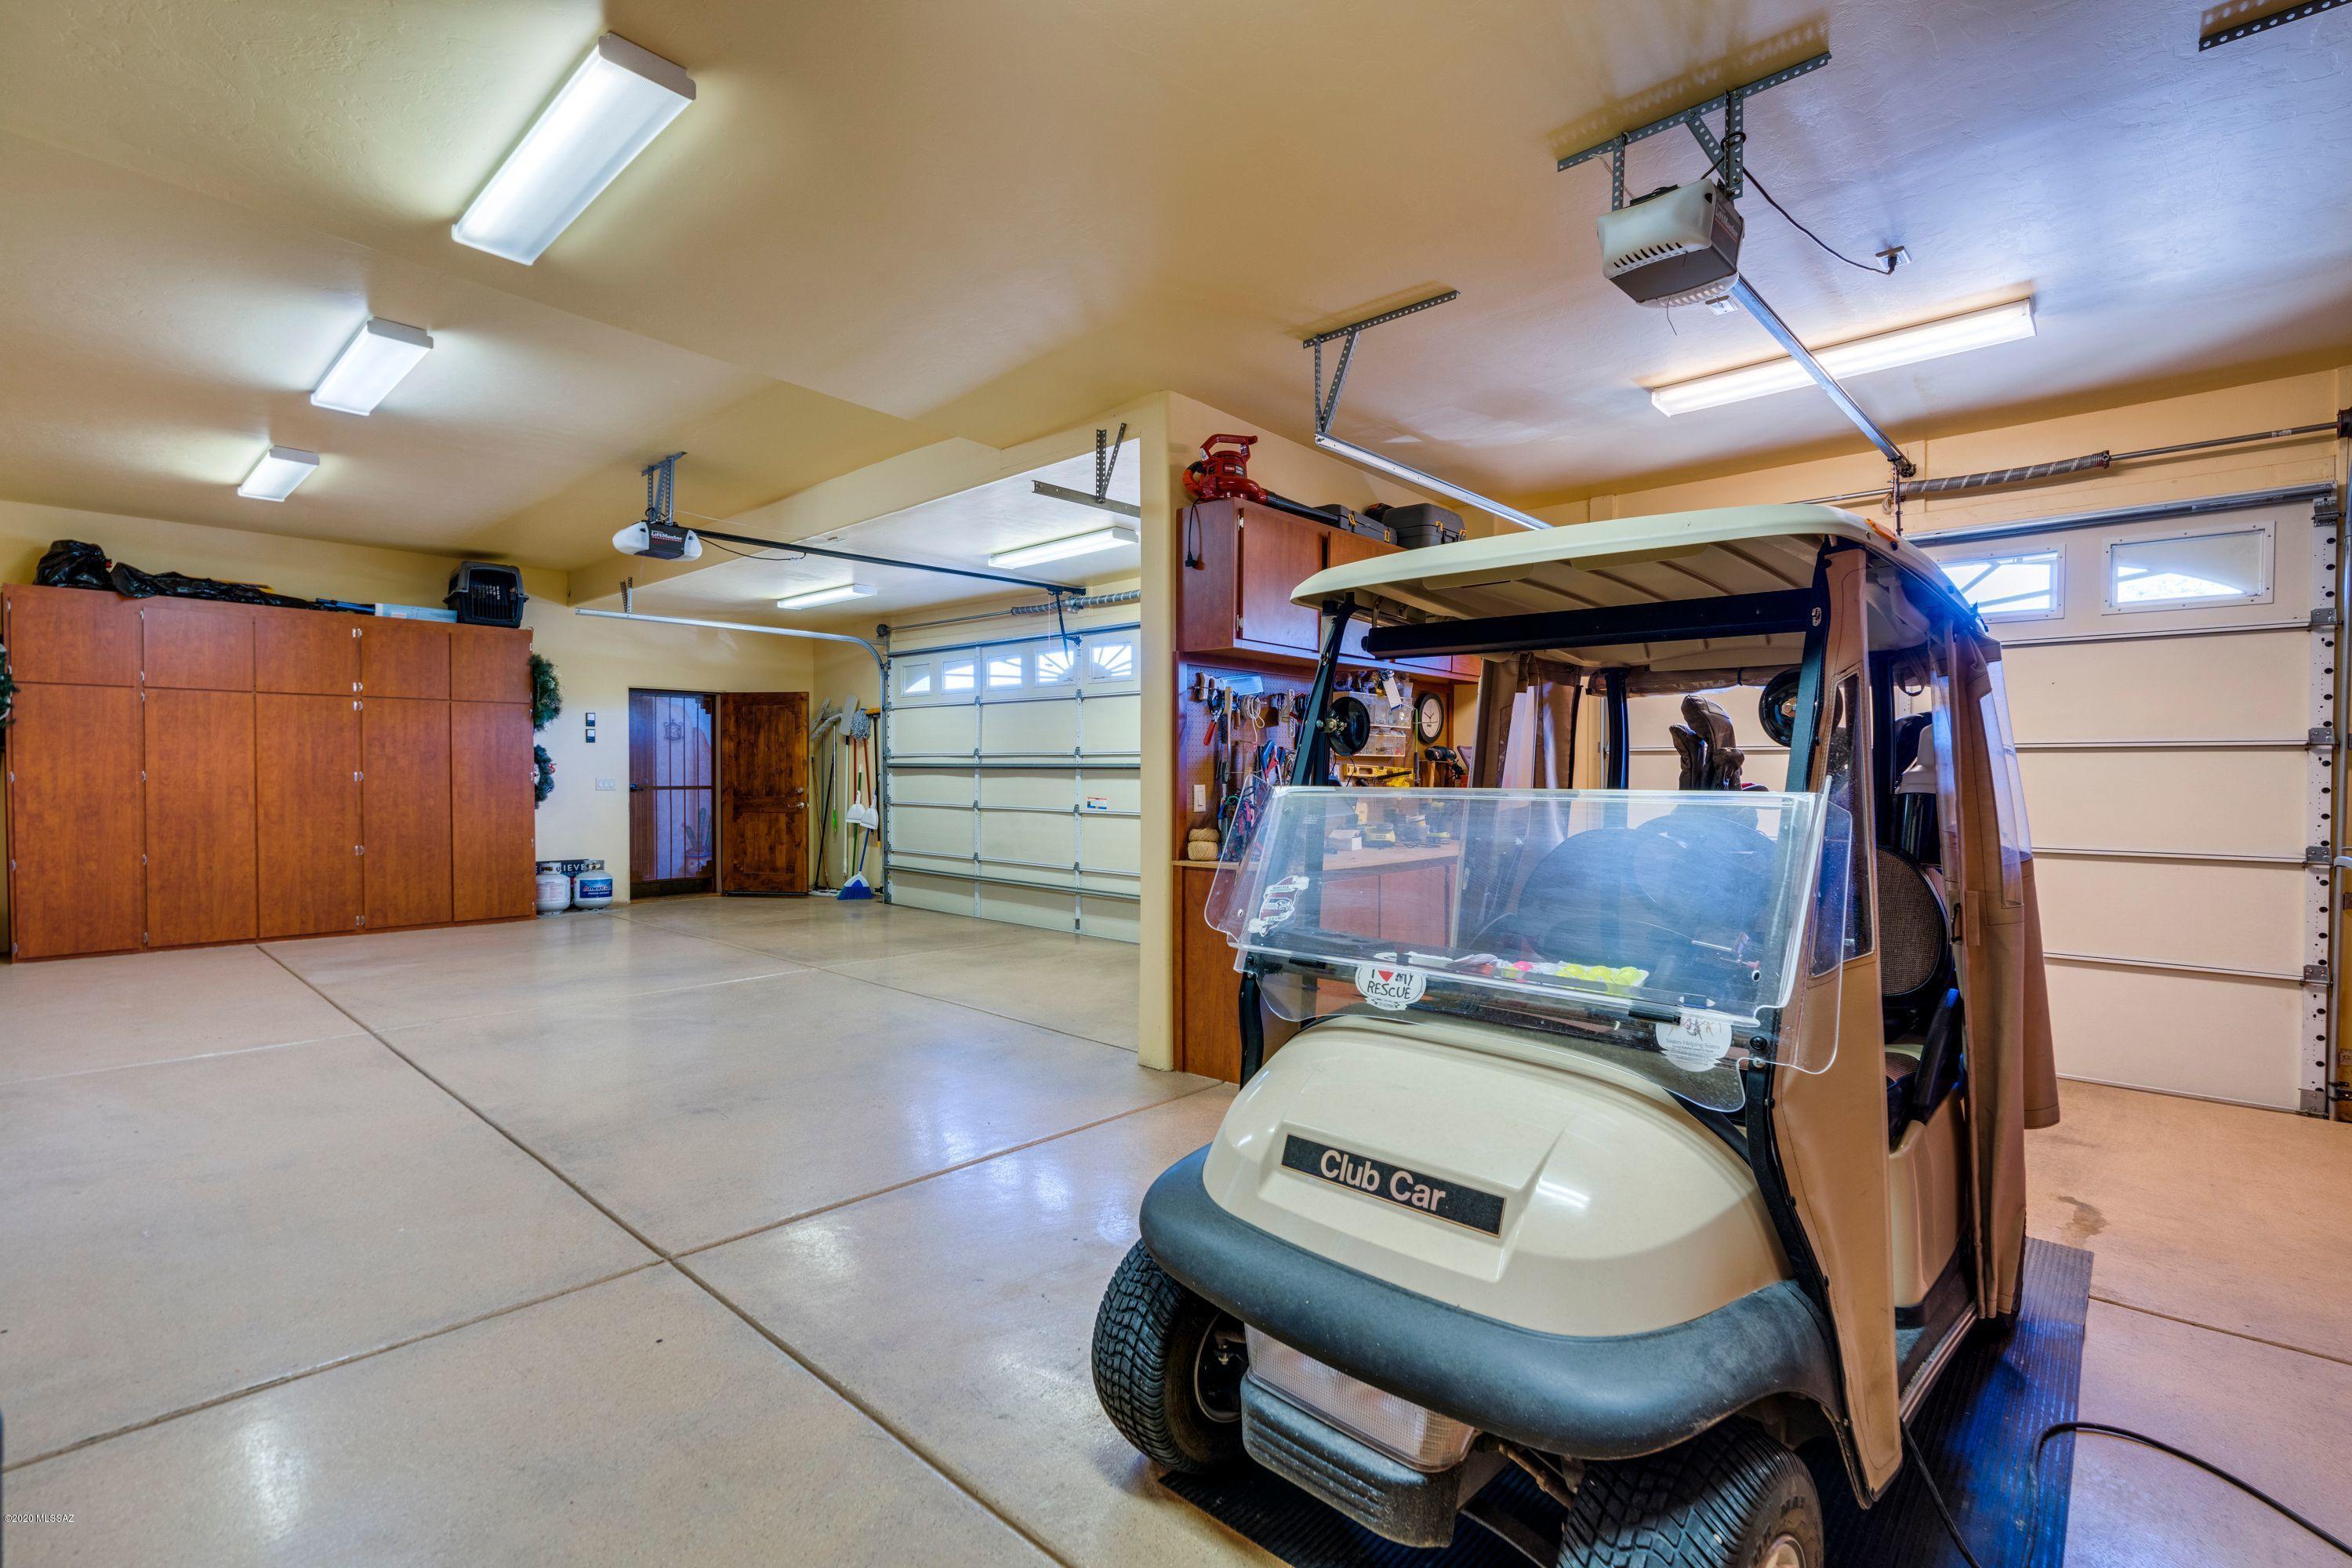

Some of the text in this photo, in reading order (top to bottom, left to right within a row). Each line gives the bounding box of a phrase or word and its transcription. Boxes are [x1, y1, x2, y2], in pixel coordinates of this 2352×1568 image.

[1371, 969, 1376, 979] I
[1367, 980, 1412, 1000] RESCUE
[1683, 1040, 1704, 1049] Helping
[1320, 1149, 1446, 1212] Club Car
